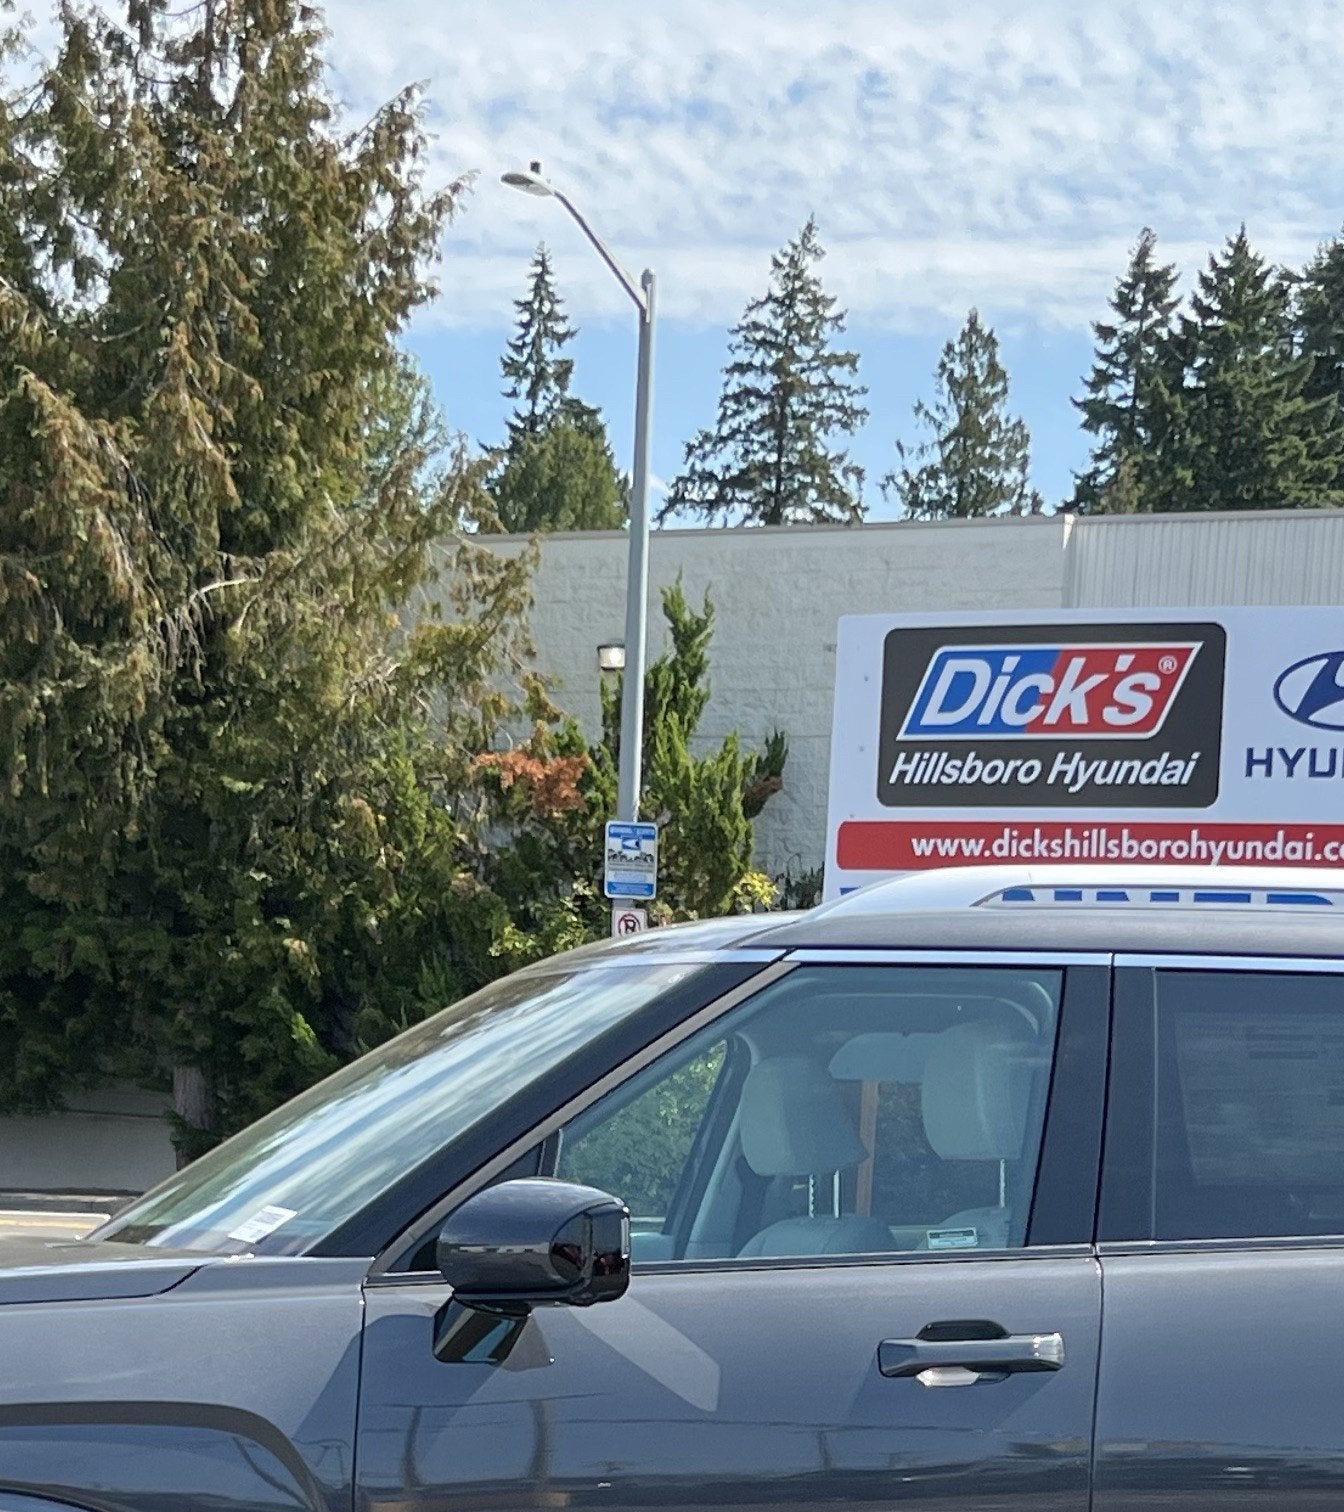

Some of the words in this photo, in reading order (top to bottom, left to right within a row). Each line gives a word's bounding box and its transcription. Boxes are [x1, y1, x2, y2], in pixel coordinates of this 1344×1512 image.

[920, 655, 1161, 726] Dick's
[889, 751, 1042, 785] Hillsboro
[1047, 751, 1202, 793] Hyundai
